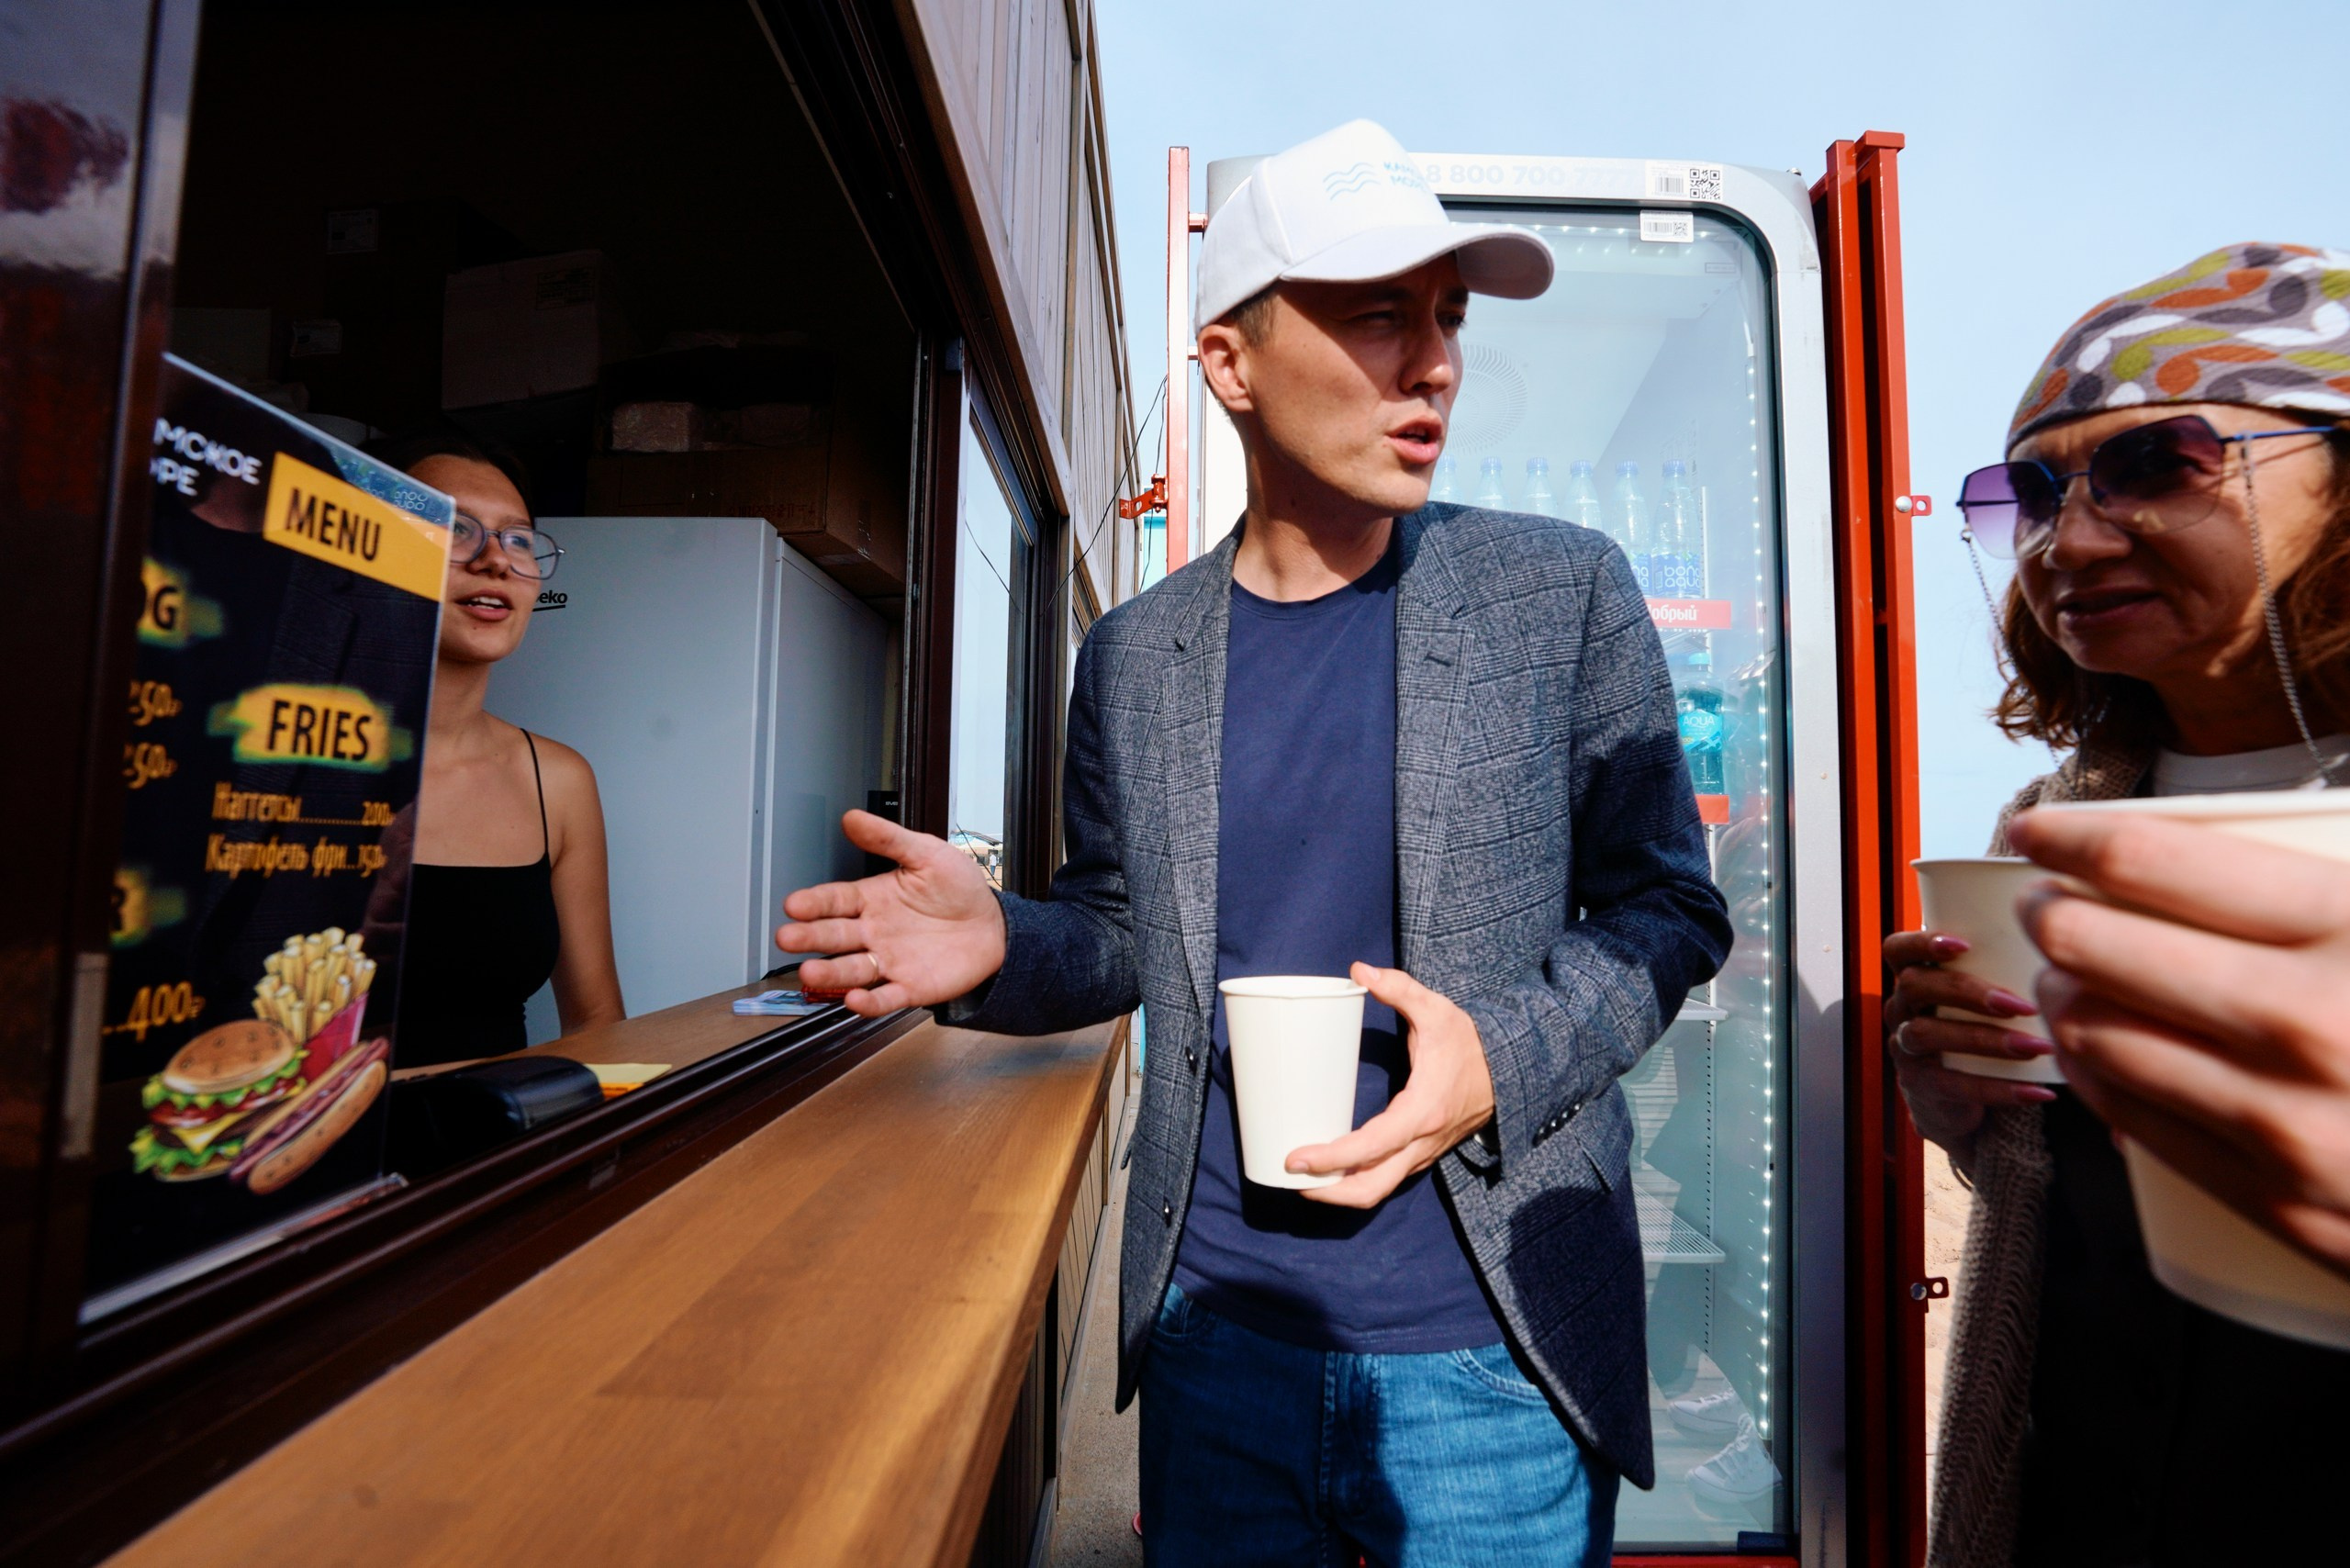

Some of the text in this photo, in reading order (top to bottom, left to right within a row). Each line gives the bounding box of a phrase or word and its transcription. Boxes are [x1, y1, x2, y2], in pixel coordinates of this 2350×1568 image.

[1425, 164, 1442, 184] 8
[1449, 164, 1505, 185] 800
[1512, 165, 1565, 185] 700
[285, 488, 383, 561] MENU
[537, 589, 568, 606] eko
[265, 699, 372, 762] FRIES
[1683, 716, 1715, 730] AQUA
